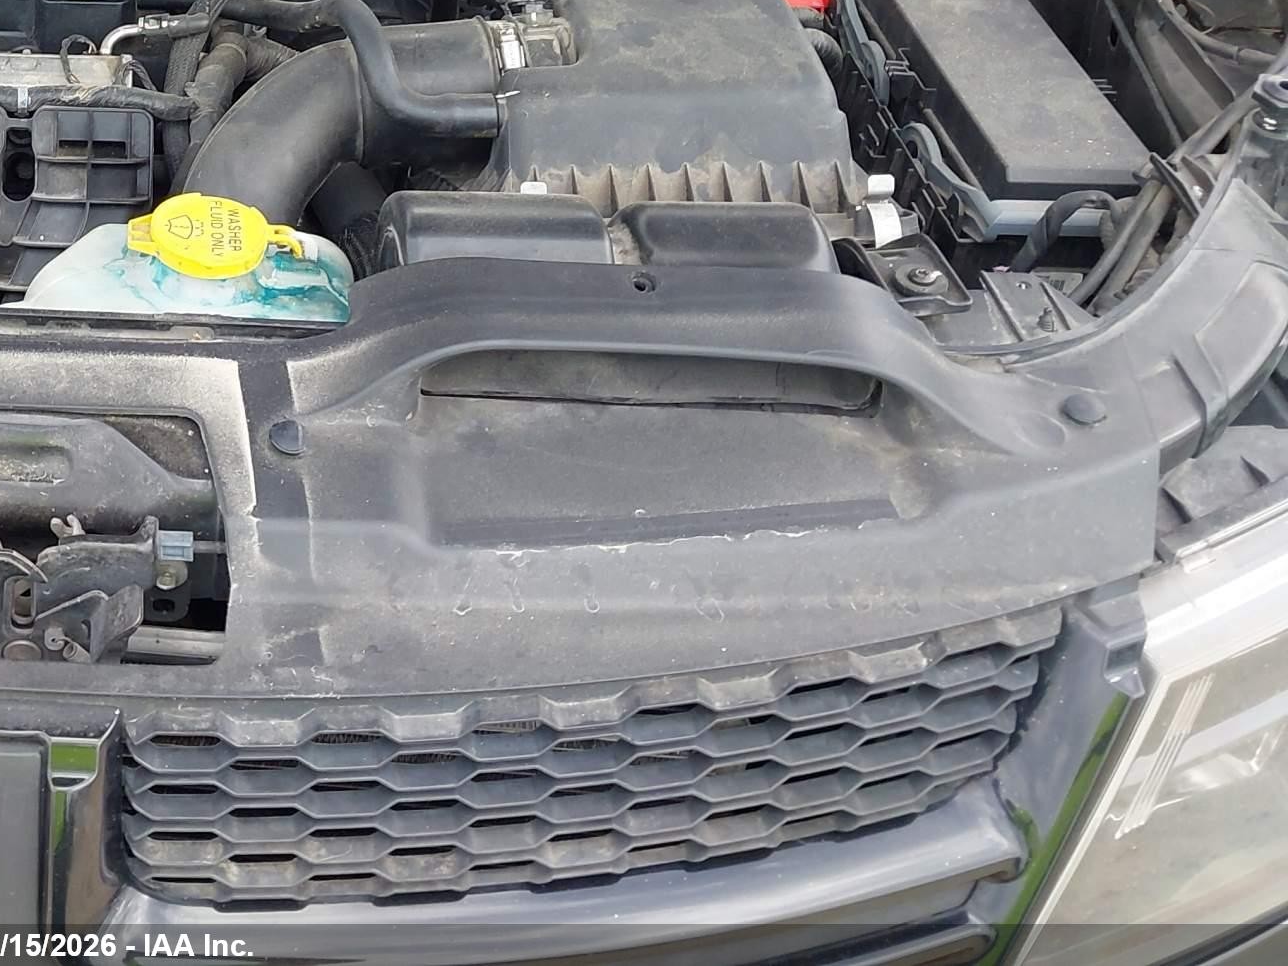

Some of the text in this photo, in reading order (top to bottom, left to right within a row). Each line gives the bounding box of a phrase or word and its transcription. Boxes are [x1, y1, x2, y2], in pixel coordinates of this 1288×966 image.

[209, 200, 225, 258] FLUID ONLY
[227, 209, 243, 252] WASHER
